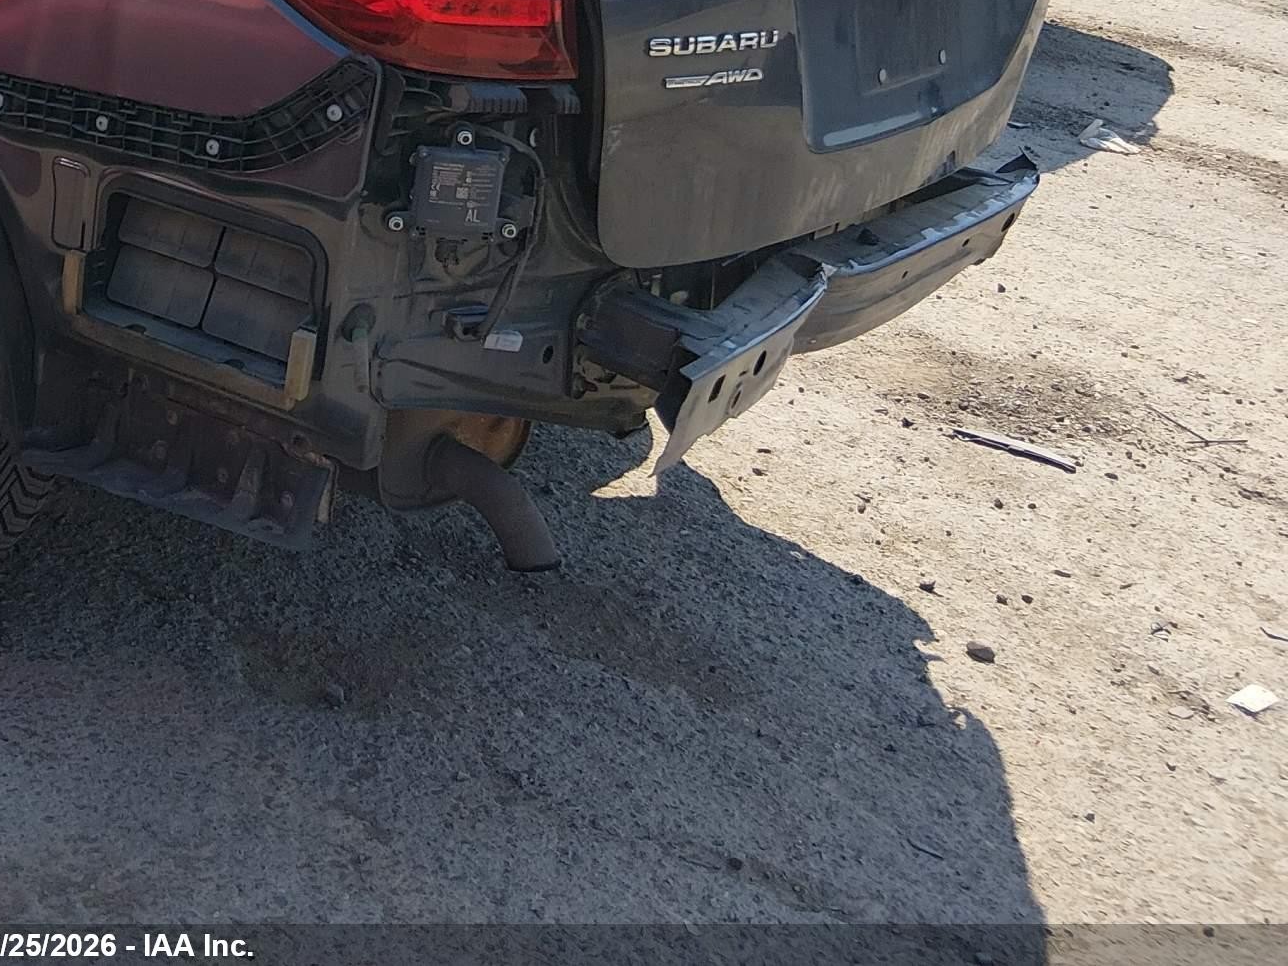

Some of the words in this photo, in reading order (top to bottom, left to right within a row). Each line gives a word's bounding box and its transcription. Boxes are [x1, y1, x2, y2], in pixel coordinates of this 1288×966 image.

[647, 30, 779, 57] SUBARU
[704, 68, 763, 86] AWD
[465, 209, 480, 223] AL
